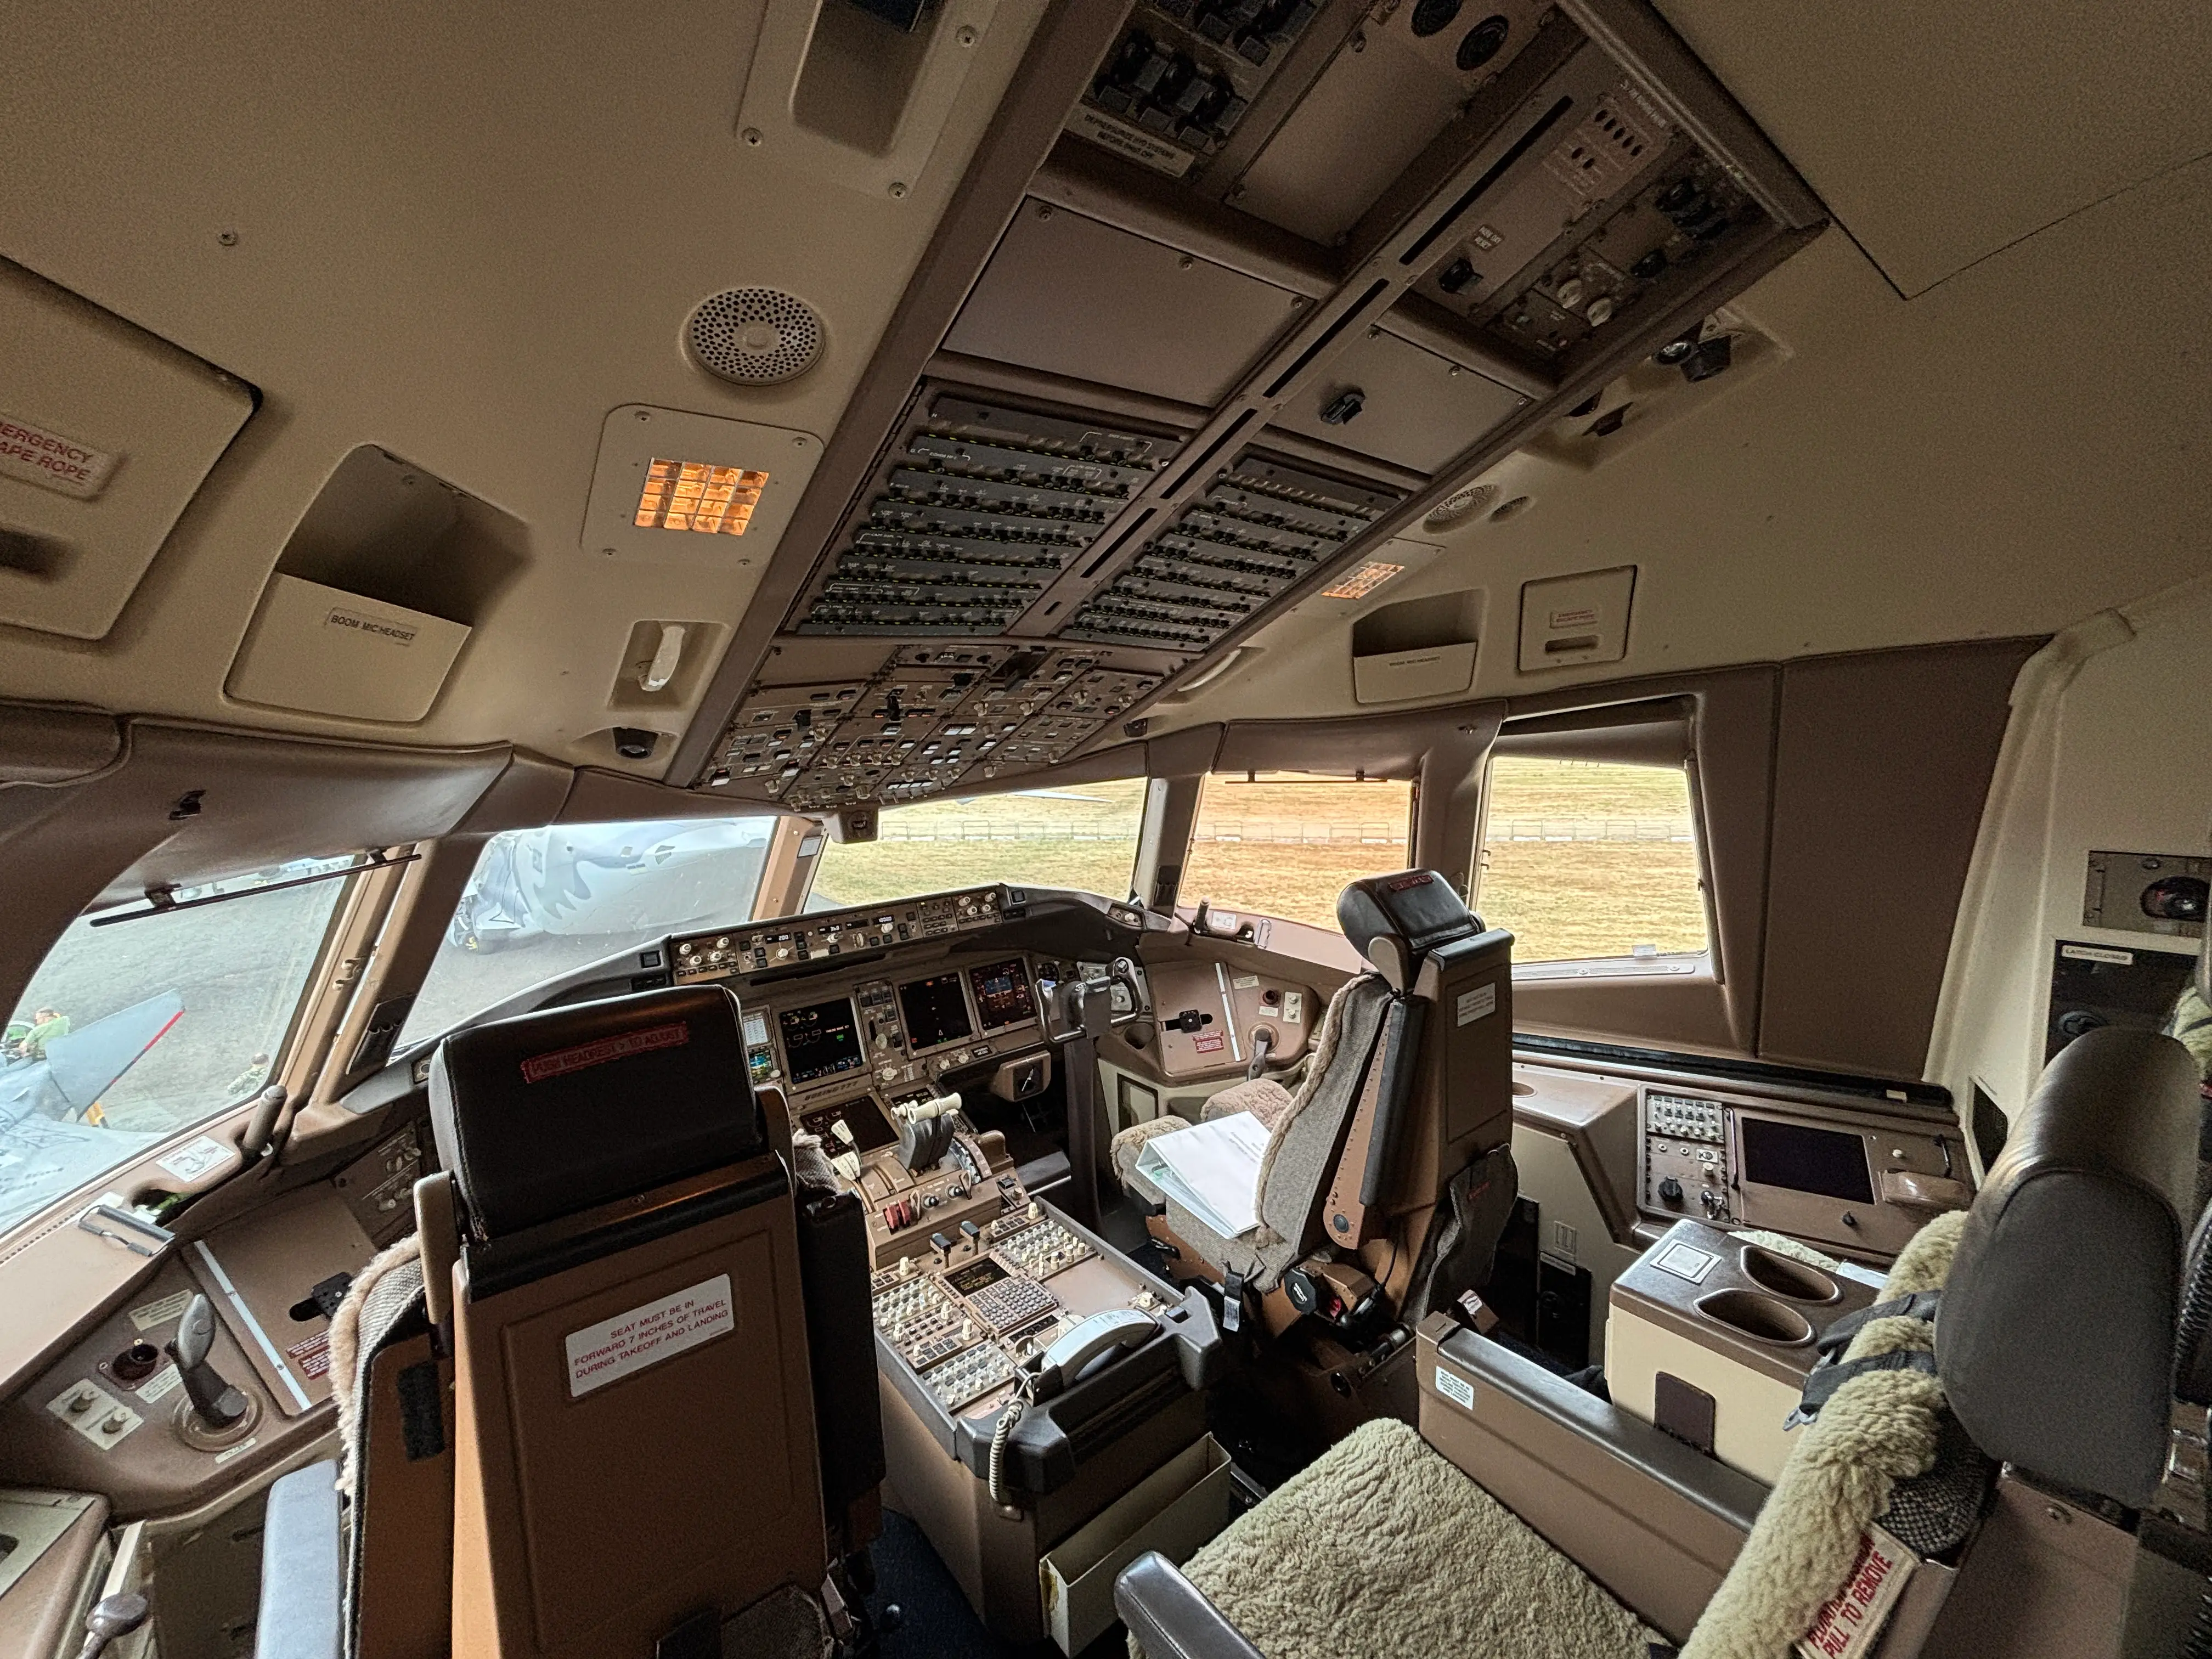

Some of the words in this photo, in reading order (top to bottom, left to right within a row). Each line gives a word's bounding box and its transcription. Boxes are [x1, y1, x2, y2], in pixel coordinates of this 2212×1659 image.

[36, 455, 92, 481] ROPE
[330, 614, 360, 629] BOOM
[361, 622, 379, 632] MIC
[379, 627, 415, 641] HEADSET
[574, 1339, 625, 1366] FORWARD
[629, 1334, 635, 1344] 7
[638, 1320, 674, 1340] INCHES
[676, 1312, 690, 1324] OF
[692, 1299, 727, 1317] TRAVEL
[610, 1322, 635, 1339] SEAT
[639, 1310, 666, 1327] MUST
[669, 1304, 682, 1316] BE
[685, 1299, 694, 1308] IN
[575, 1356, 616, 1379] DURING
[619, 1337, 662, 1361] TAKEOFF
[665, 1327, 685, 1341] AND
[687, 1309, 729, 1332] LANDING
[1851, 1550, 1893, 1608] REMOVE
[1840, 1602, 1863, 1627] TO
[1822, 1624, 1850, 1659] PULL
